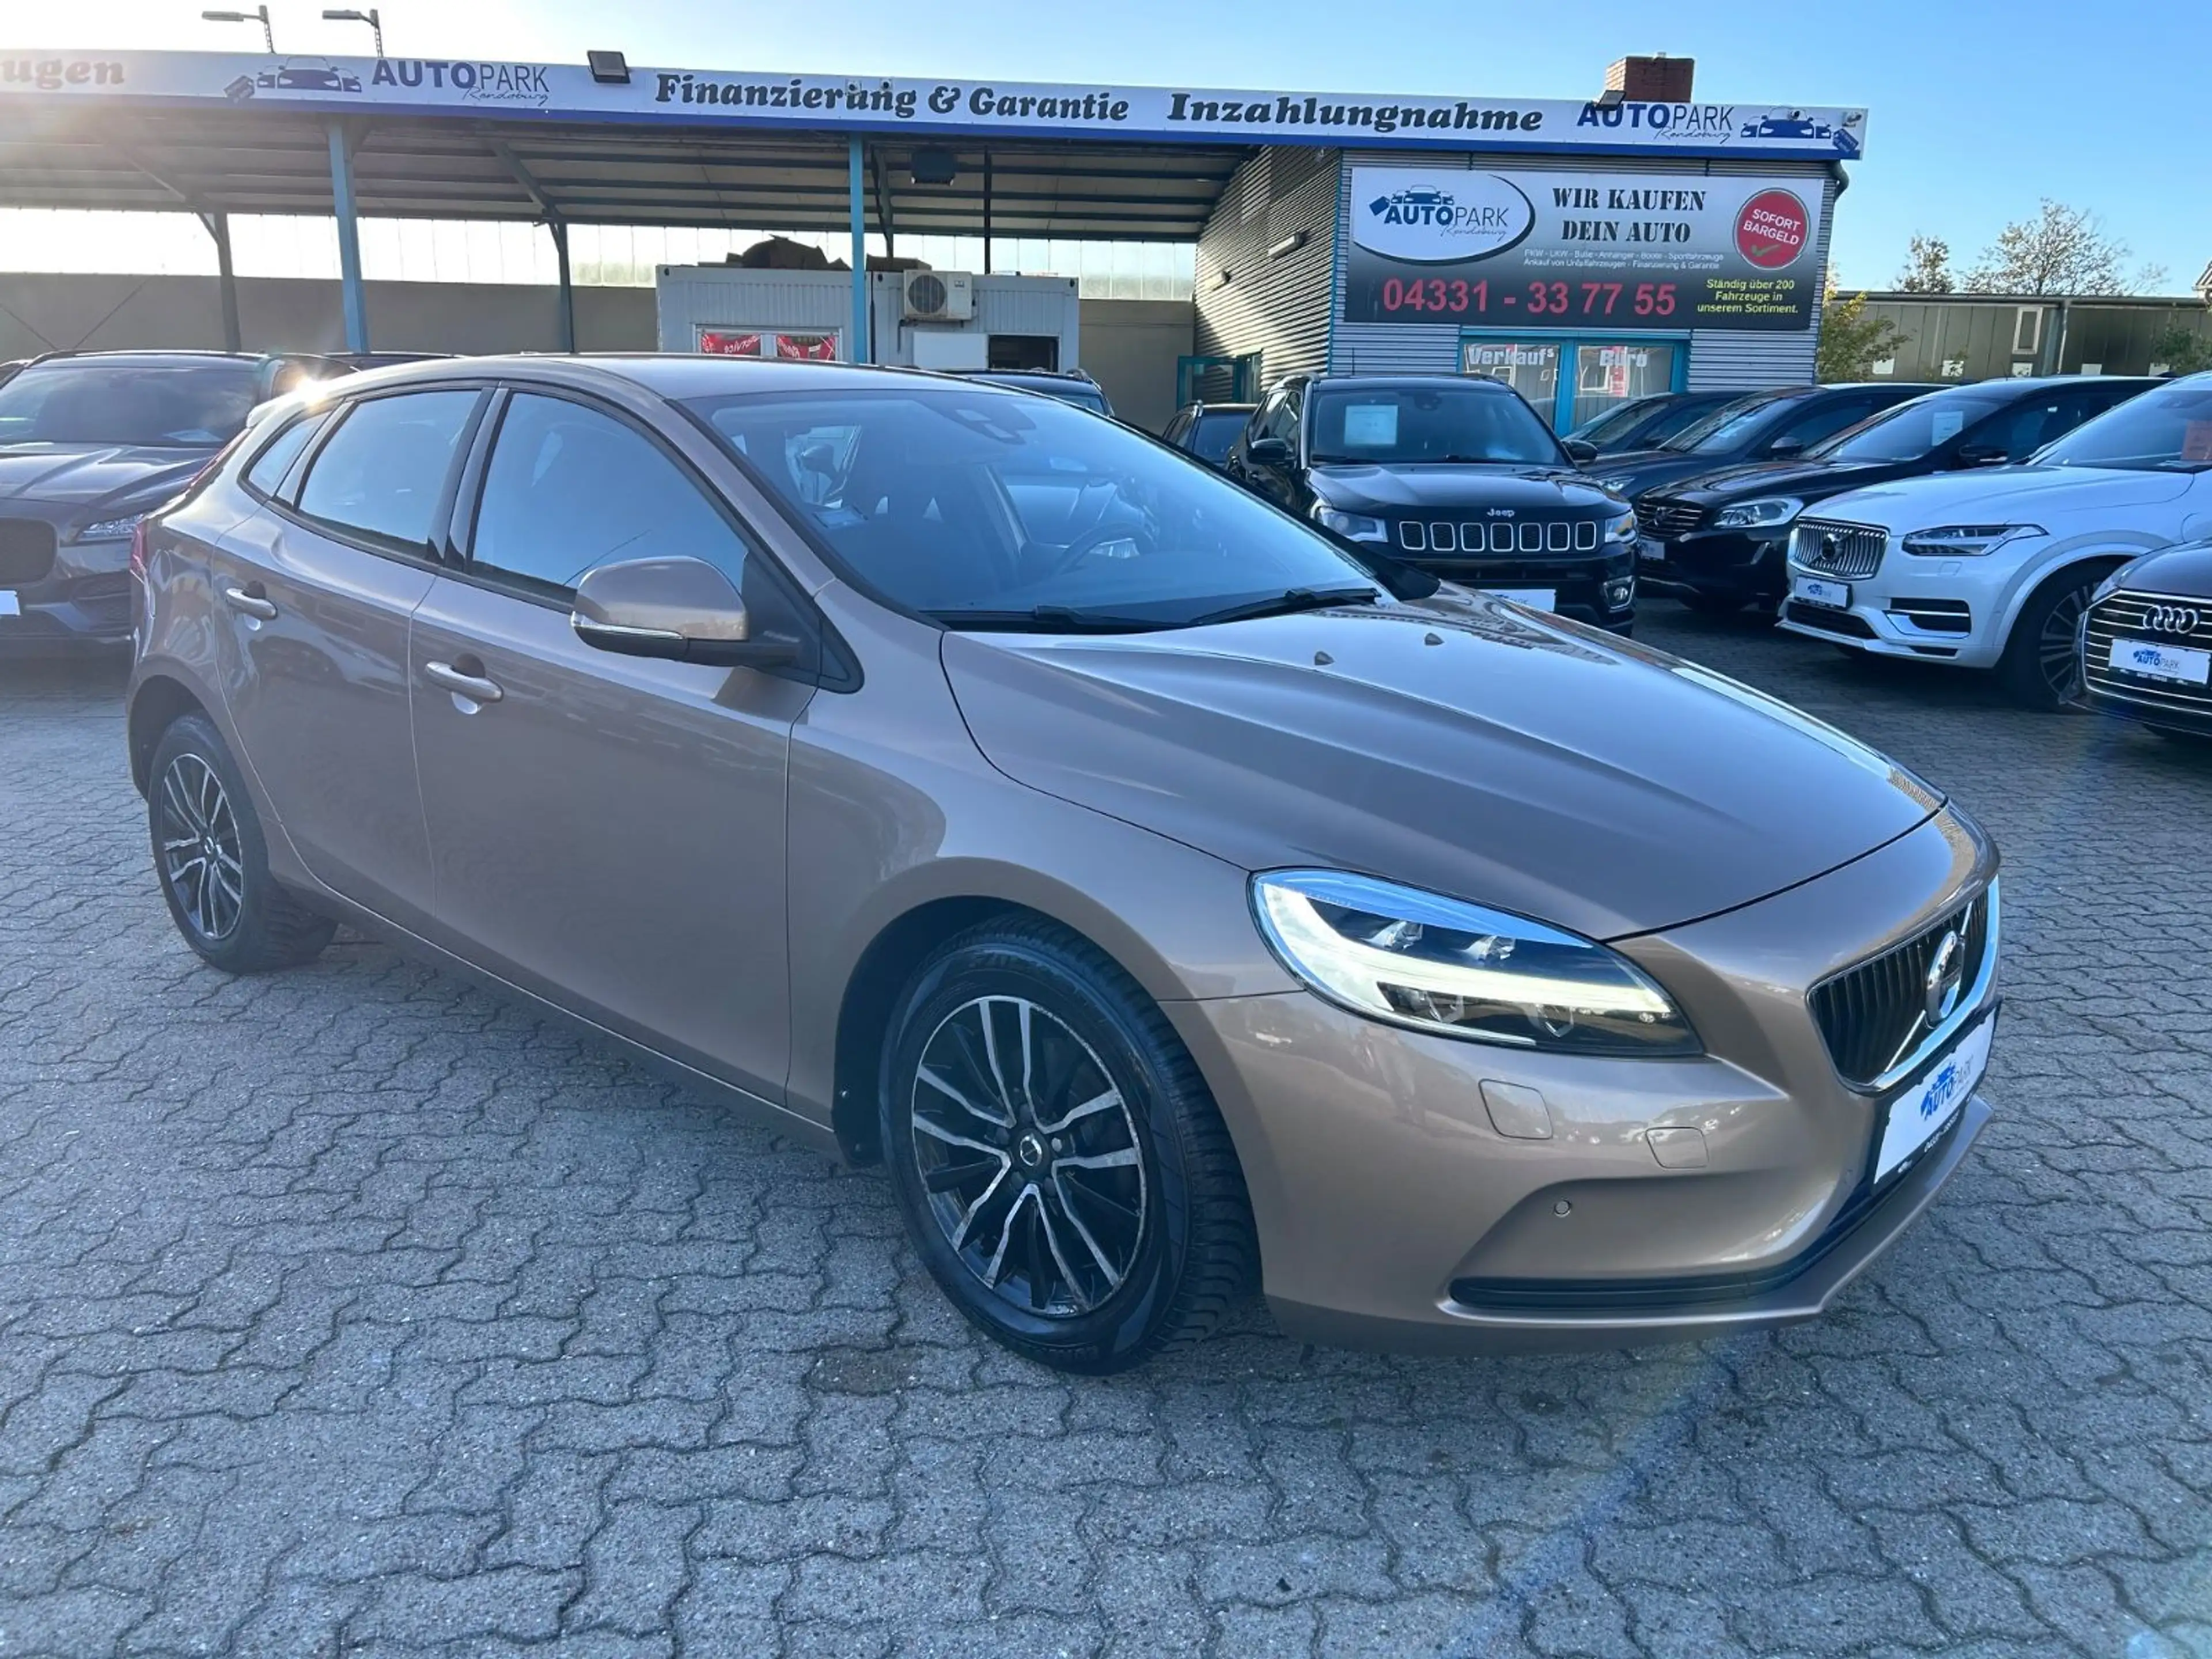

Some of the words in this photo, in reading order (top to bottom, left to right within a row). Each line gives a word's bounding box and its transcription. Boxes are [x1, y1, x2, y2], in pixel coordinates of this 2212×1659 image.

[372, 59, 550, 92] AUTOPARK
[656, 73, 917, 118] Finanzierung
[928, 86, 961, 114] &
[969, 87, 1130, 121] Garantie
[1166, 93, 1544, 133] Inzahlungnahme
[1577, 102, 1734, 131] AUTOPARK
[1552, 188, 1599, 209] WIR
[1607, 189, 1707, 211] KAUFEN
[1384, 206, 1509, 227] AUTOPARK
[1752, 209, 1801, 231] SOFORT
[1561, 220, 1620, 241] DEIN
[1626, 222, 1691, 243] AUTO
[1744, 220, 1799, 245] BARGELD
[1706, 279, 1747, 291] Ständig
[1749, 279, 1774, 289] über
[1775, 279, 1795, 290] 200
[1384, 279, 1488, 312] 04331
[1528, 282, 1568, 313] 33
[1582, 283, 1623, 315] 77
[1634, 283, 1676, 315] 55
[1698, 304, 1742, 313] unserem
[1745, 304, 1798, 313] Sortiment.
[1715, 291, 1770, 303] Fahrzeuge
[1772, 291, 1783, 301] in
[1487, 508, 1515, 518] Jeep
